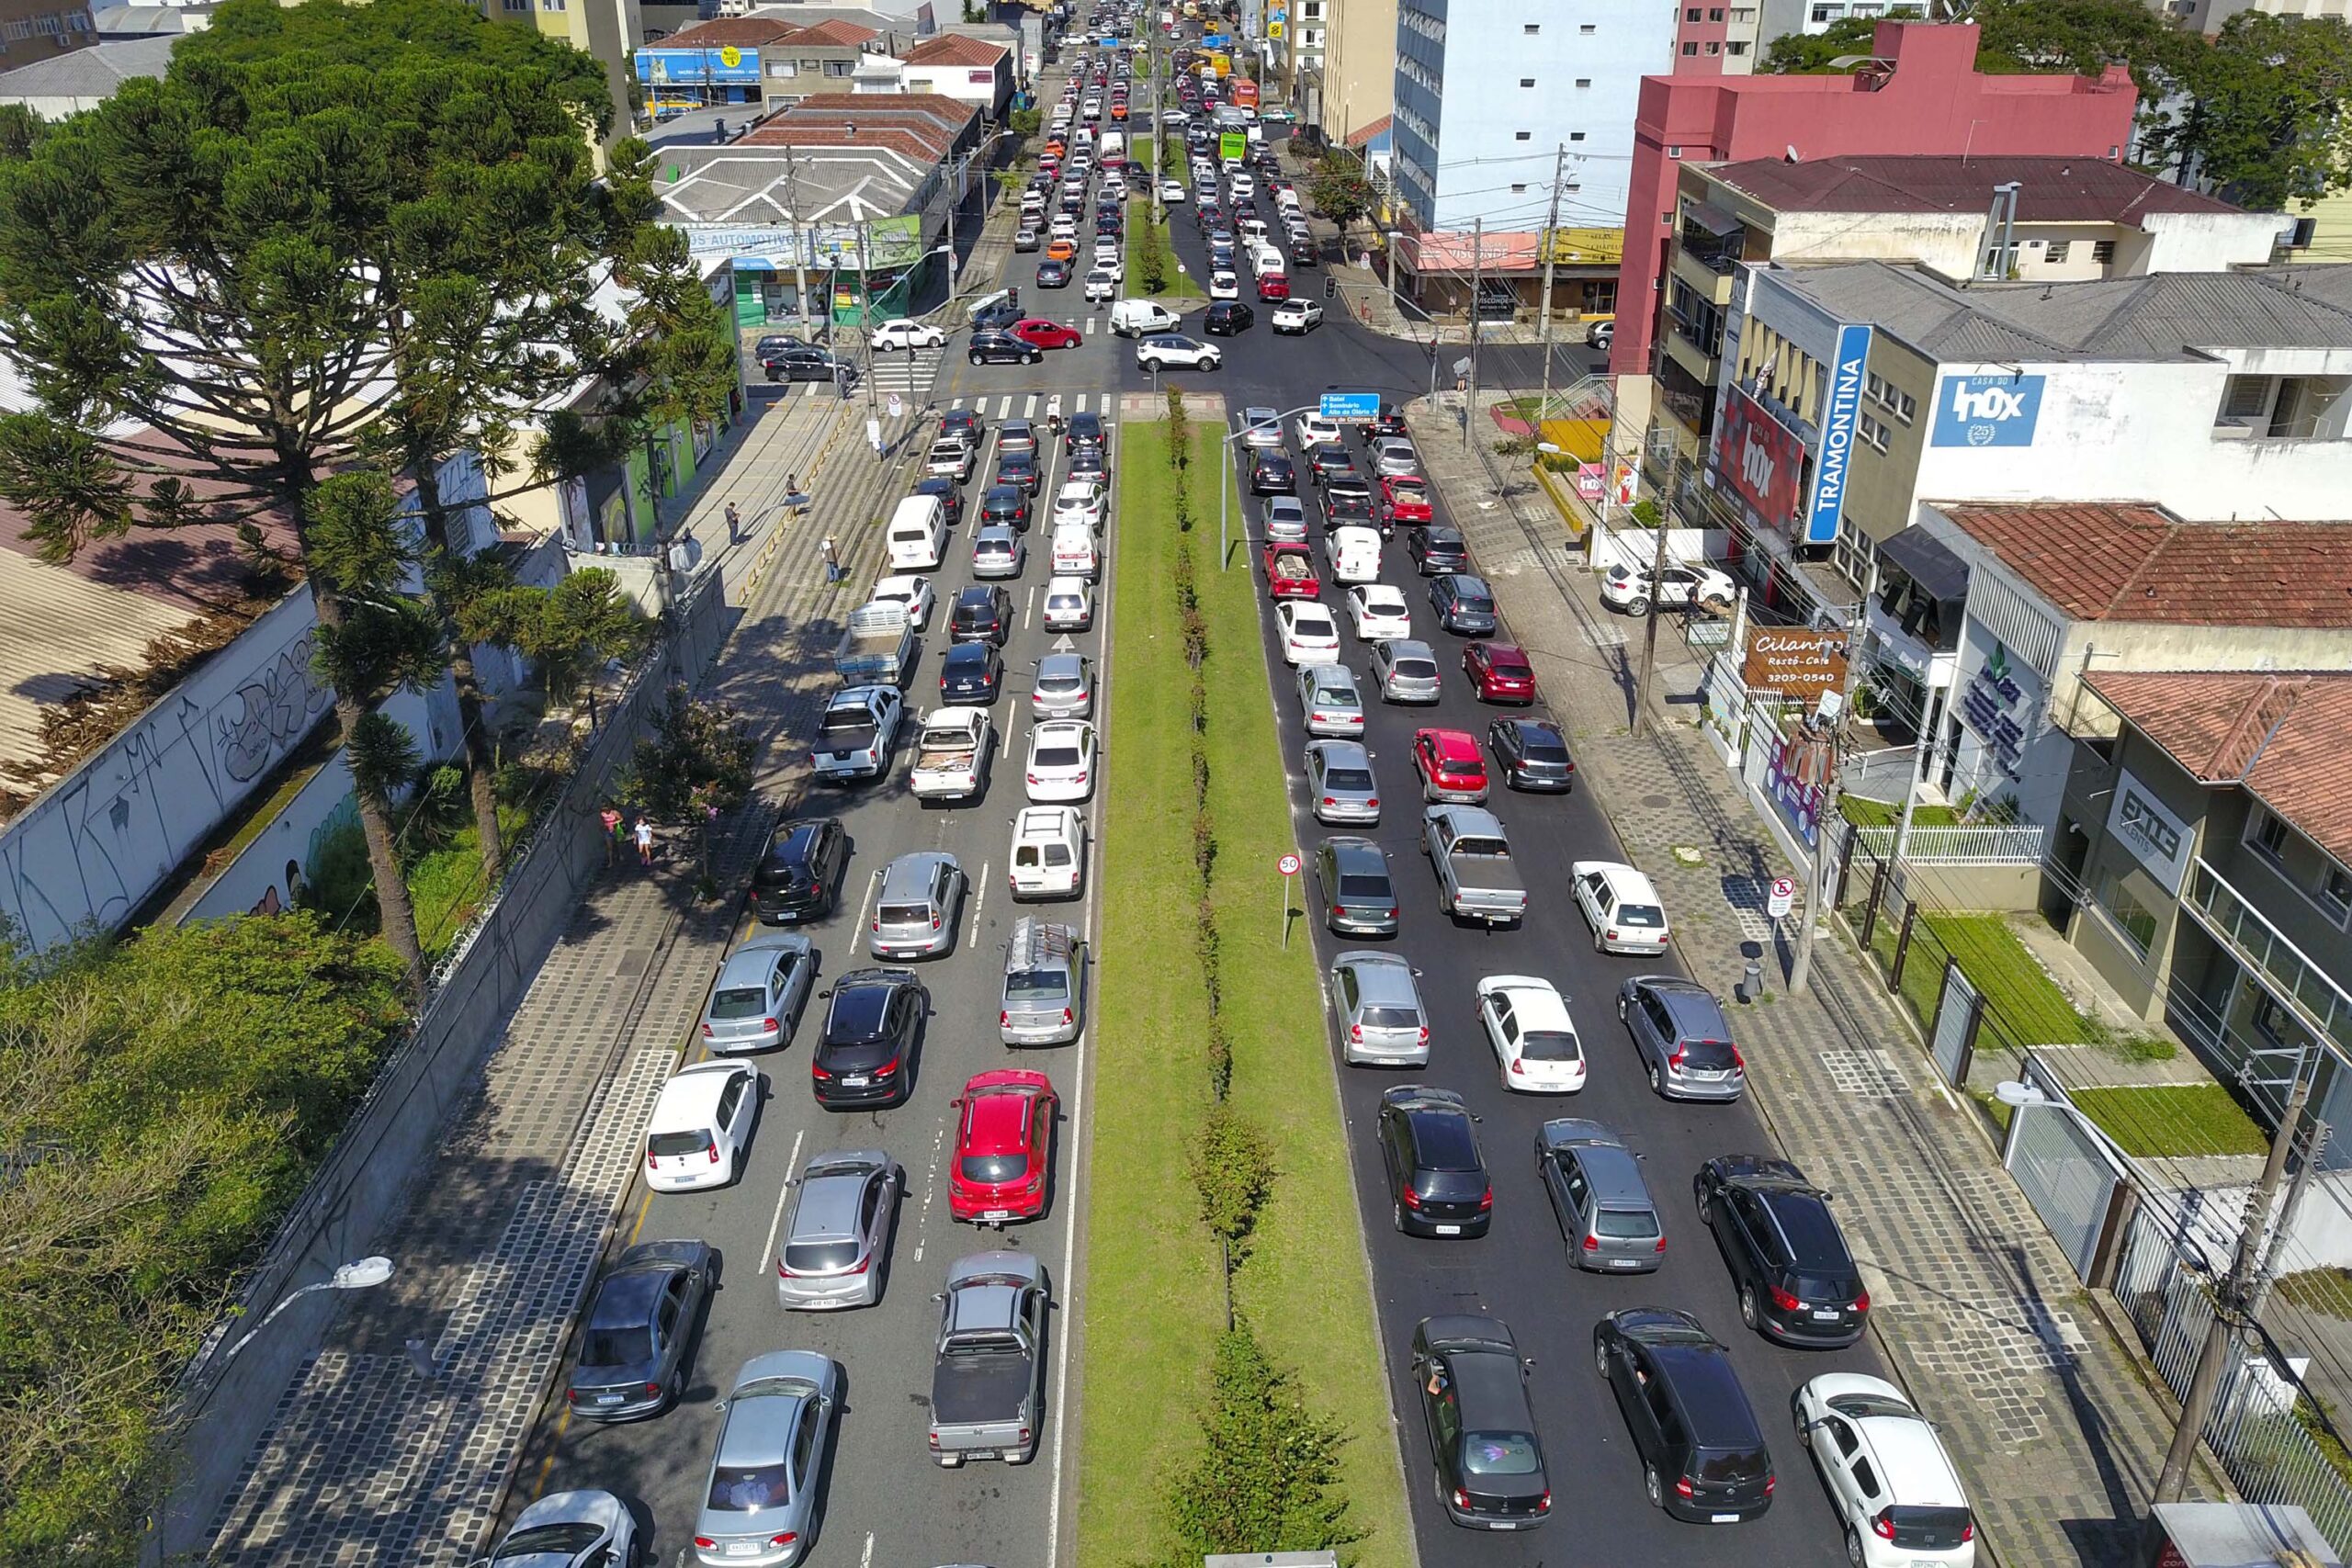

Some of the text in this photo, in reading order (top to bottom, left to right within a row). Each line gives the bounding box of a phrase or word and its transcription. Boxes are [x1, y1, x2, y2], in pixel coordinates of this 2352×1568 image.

[711, 234, 803, 246] AUTOMOTIVO
[1972, 377, 2008, 386] CASA DO
[1817, 357, 1861, 513] TRAMONTINA
[1973, 424, 1989, 435] 25
[1756, 636, 1843, 652] Cilanto
[1768, 673, 1835, 682] 3209-0540
[1282, 859, 1296, 868] 50
